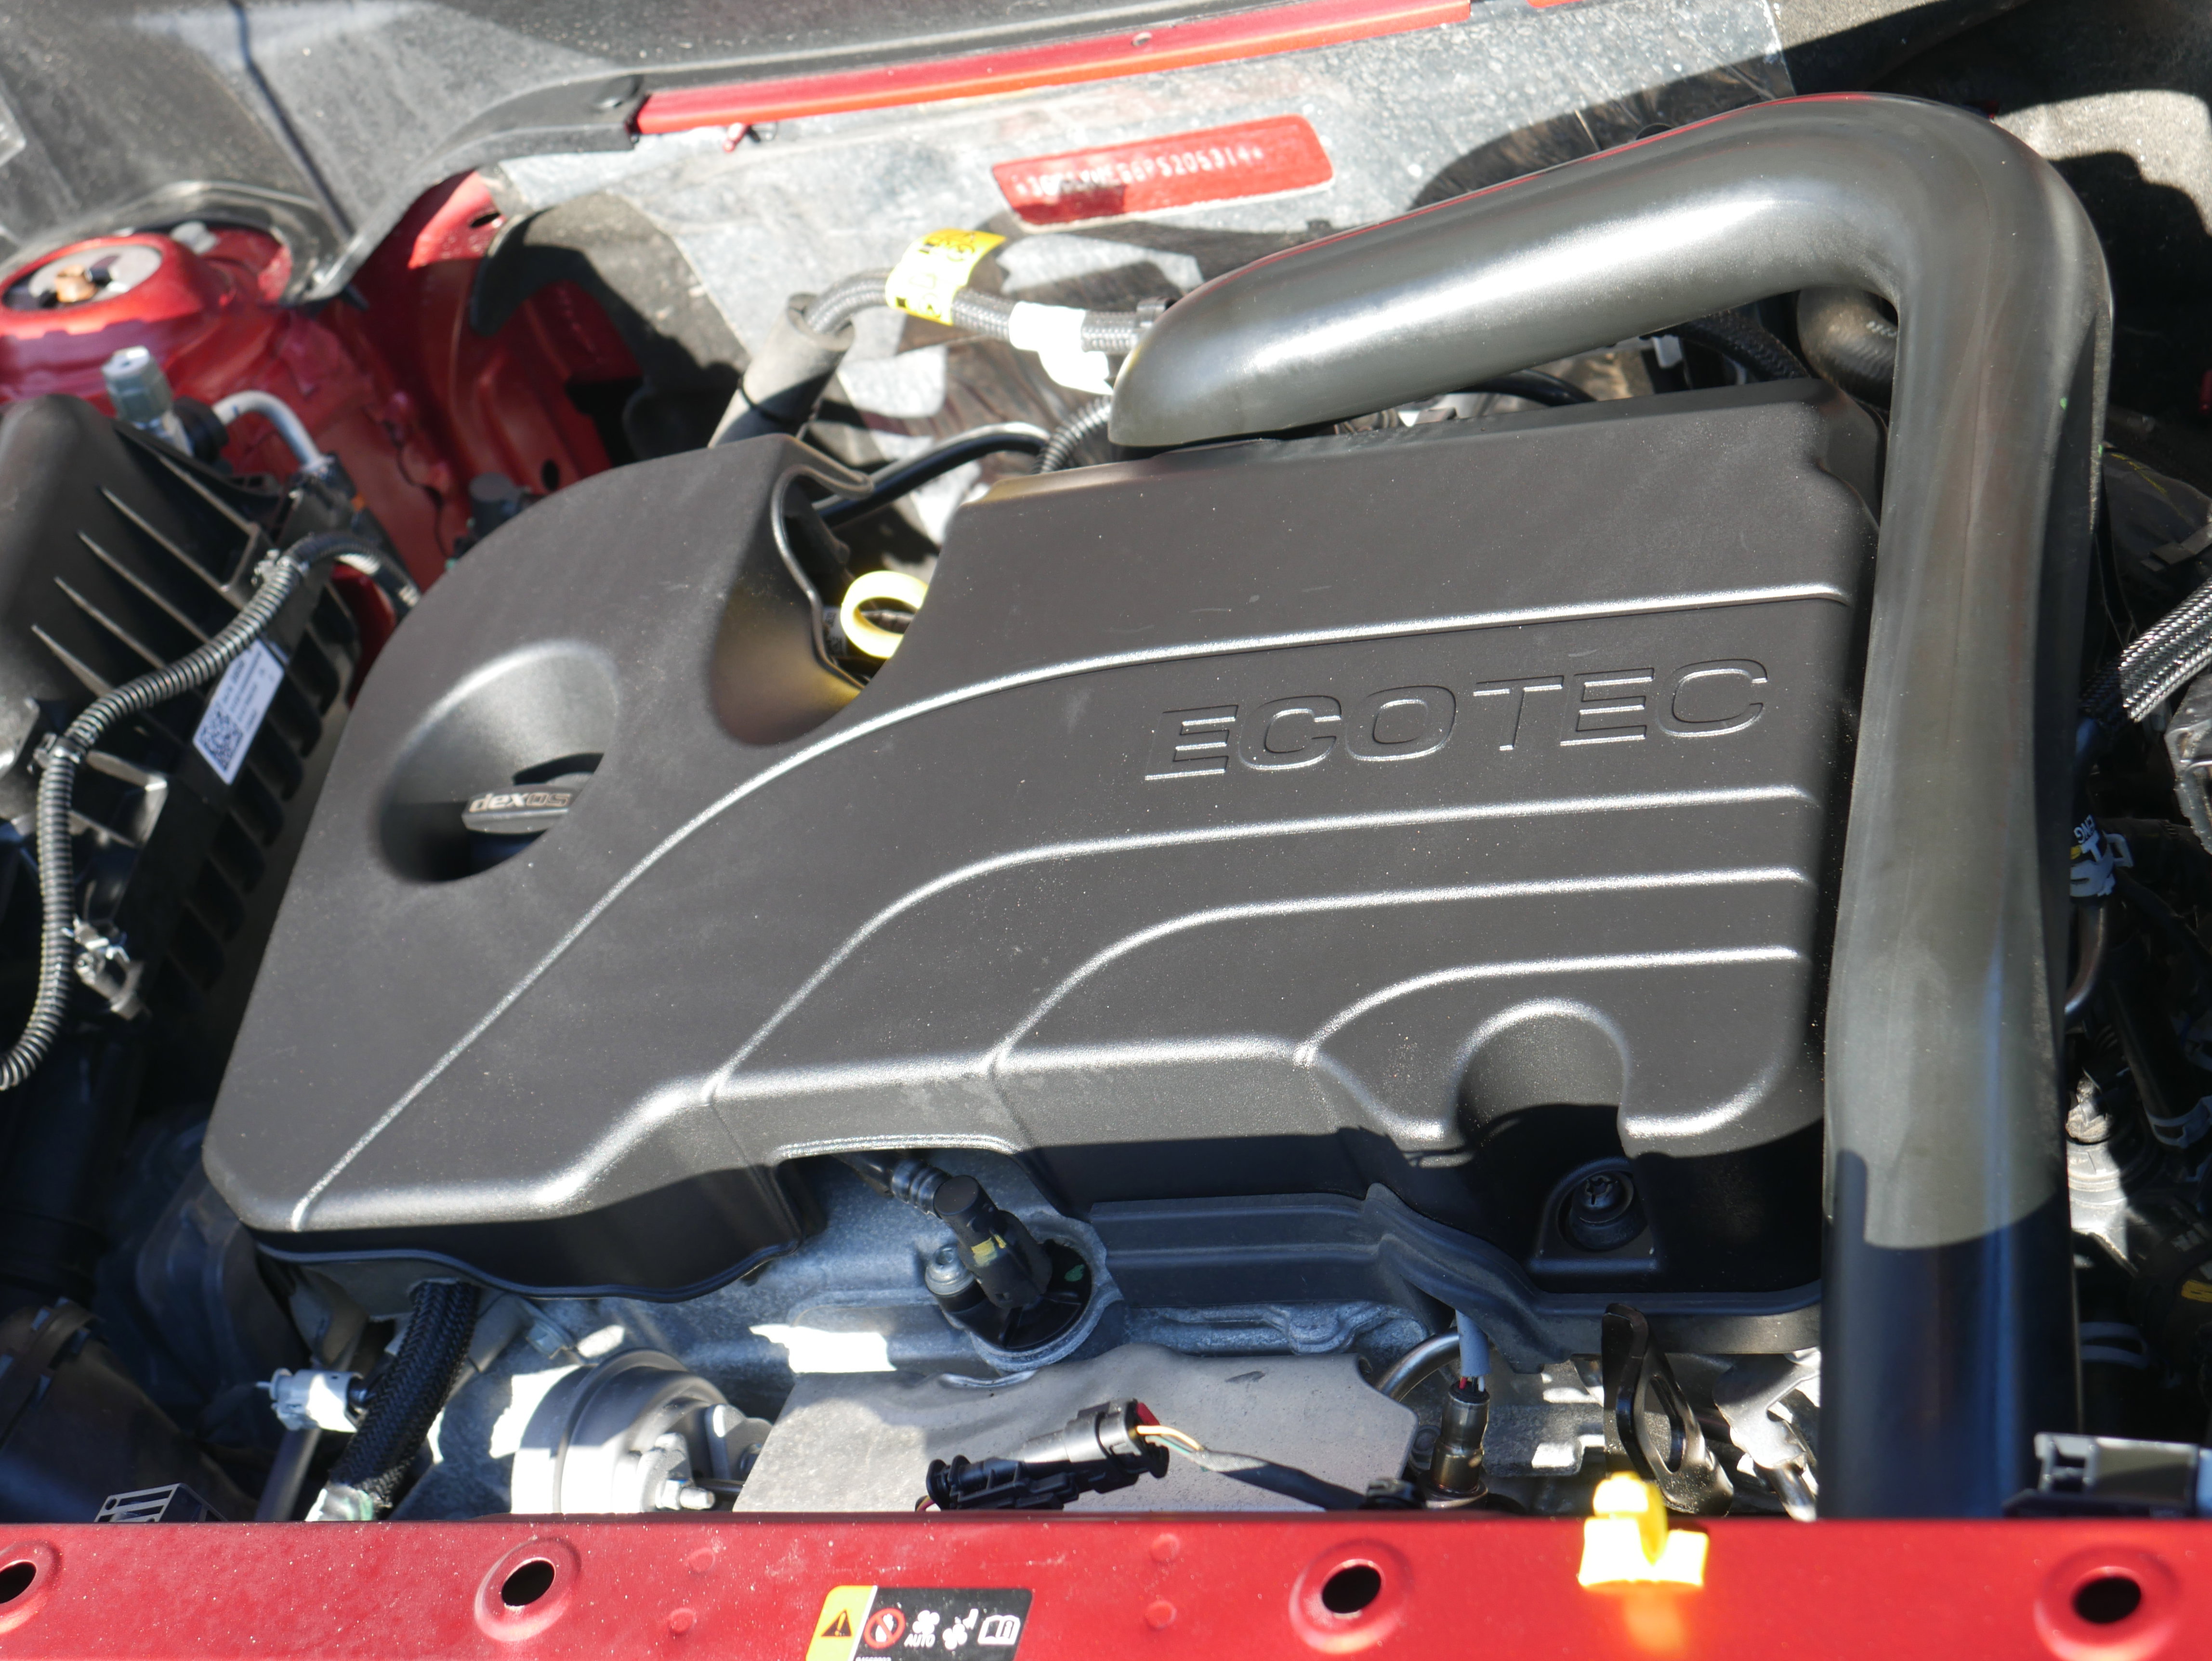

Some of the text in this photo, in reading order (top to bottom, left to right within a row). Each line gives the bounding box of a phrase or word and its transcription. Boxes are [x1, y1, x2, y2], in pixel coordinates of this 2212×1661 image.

[1145, 657, 1768, 781] ECOTEC
[469, 792, 571, 813] dexos
[904, 1633, 935, 1648] AUTO
